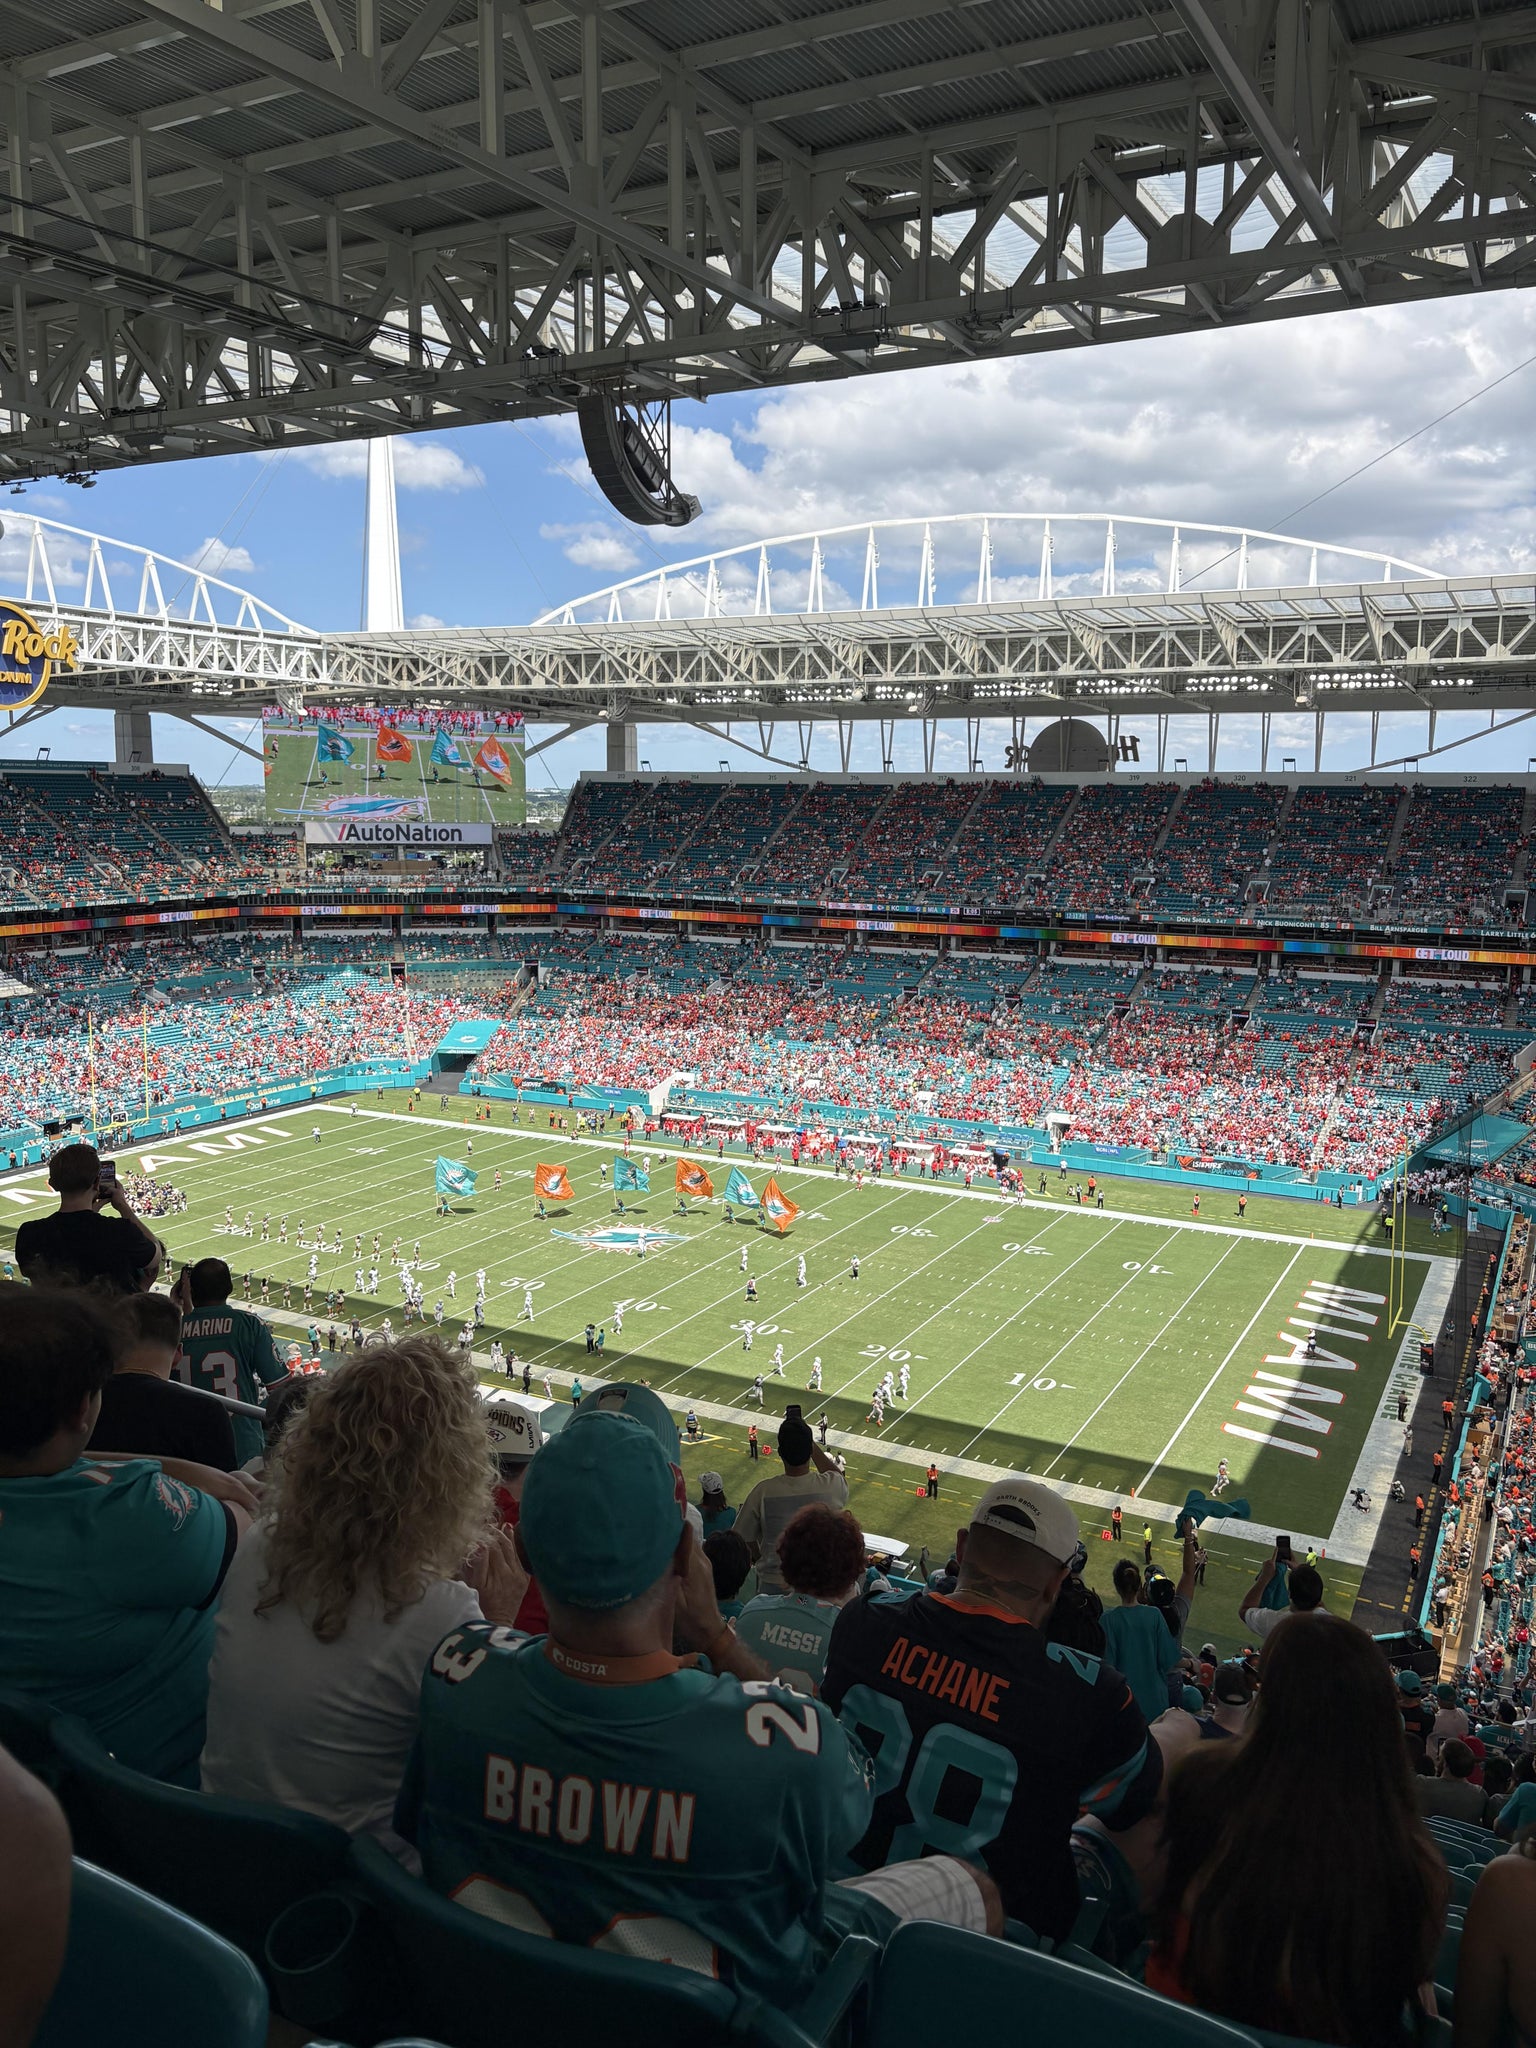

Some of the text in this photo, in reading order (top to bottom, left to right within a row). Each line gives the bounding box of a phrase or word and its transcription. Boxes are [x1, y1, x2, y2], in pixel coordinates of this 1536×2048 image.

[2, 619, 78, 668] Rock
[345, 824, 463, 842] AutoNation
[321, 905, 342, 915] LOUD
[875, 921, 895, 930] LOUD
[1192, 916, 1211, 924] SHULA
[1257, 919, 1273, 927] NICK
[1275, 920, 1315, 928] BUONICONTI
[1385, 925, 1428, 934] ARNSPARGER
[1481, 930, 1504, 938] LARRY
[1507, 930, 1529, 939] LITTLE
[1112, 932, 1157, 944] GET LOUD
[1415, 948, 1470, 961] GET LOUD
[250, 1097, 281, 1111] Dolhins
[1001, 1242, 1048, 1255] 20
[1121, 1261, 1164, 1274] 10
[500, 1276, 546, 1291] 50
[182, 1317, 233, 1338] MARINO
[858, 1344, 912, 1362] 20
[1221, 1279, 1388, 1459] MIAMI
[1004, 1371, 1057, 1391] 10
[488, 1410, 525, 1436] PIONS
[760, 1621, 823, 1656] MESSI
[565, 1657, 607, 1676] COSTA
[881, 1637, 1011, 1723] ACHANE
[484, 1753, 696, 1864] BROWN
